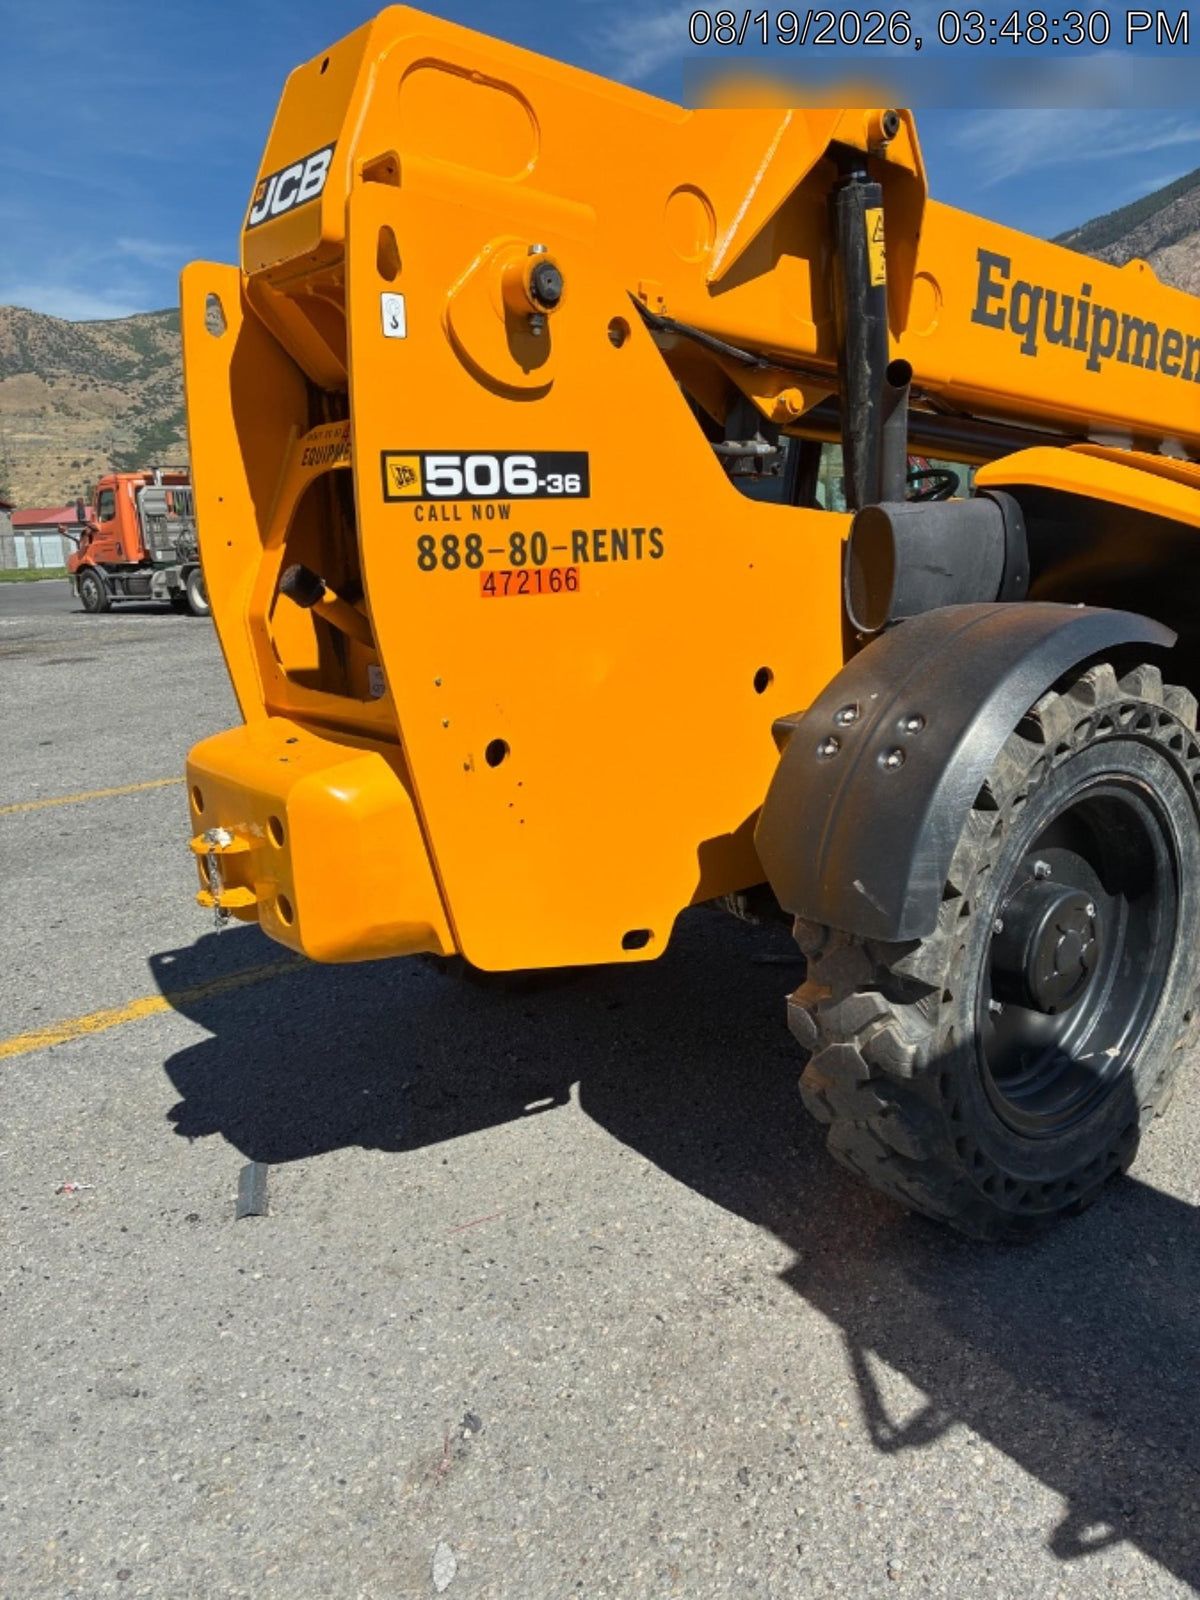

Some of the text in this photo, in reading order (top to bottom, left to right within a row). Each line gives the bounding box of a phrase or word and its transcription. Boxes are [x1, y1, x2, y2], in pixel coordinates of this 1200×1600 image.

[249, 148, 333, 225] JCB
[424, 455, 582, 497] 506-36
[414, 504, 512, 522] CALL NOW
[417, 527, 664, 571] 888-80-RENTS
[482, 567, 578, 596] 472166
